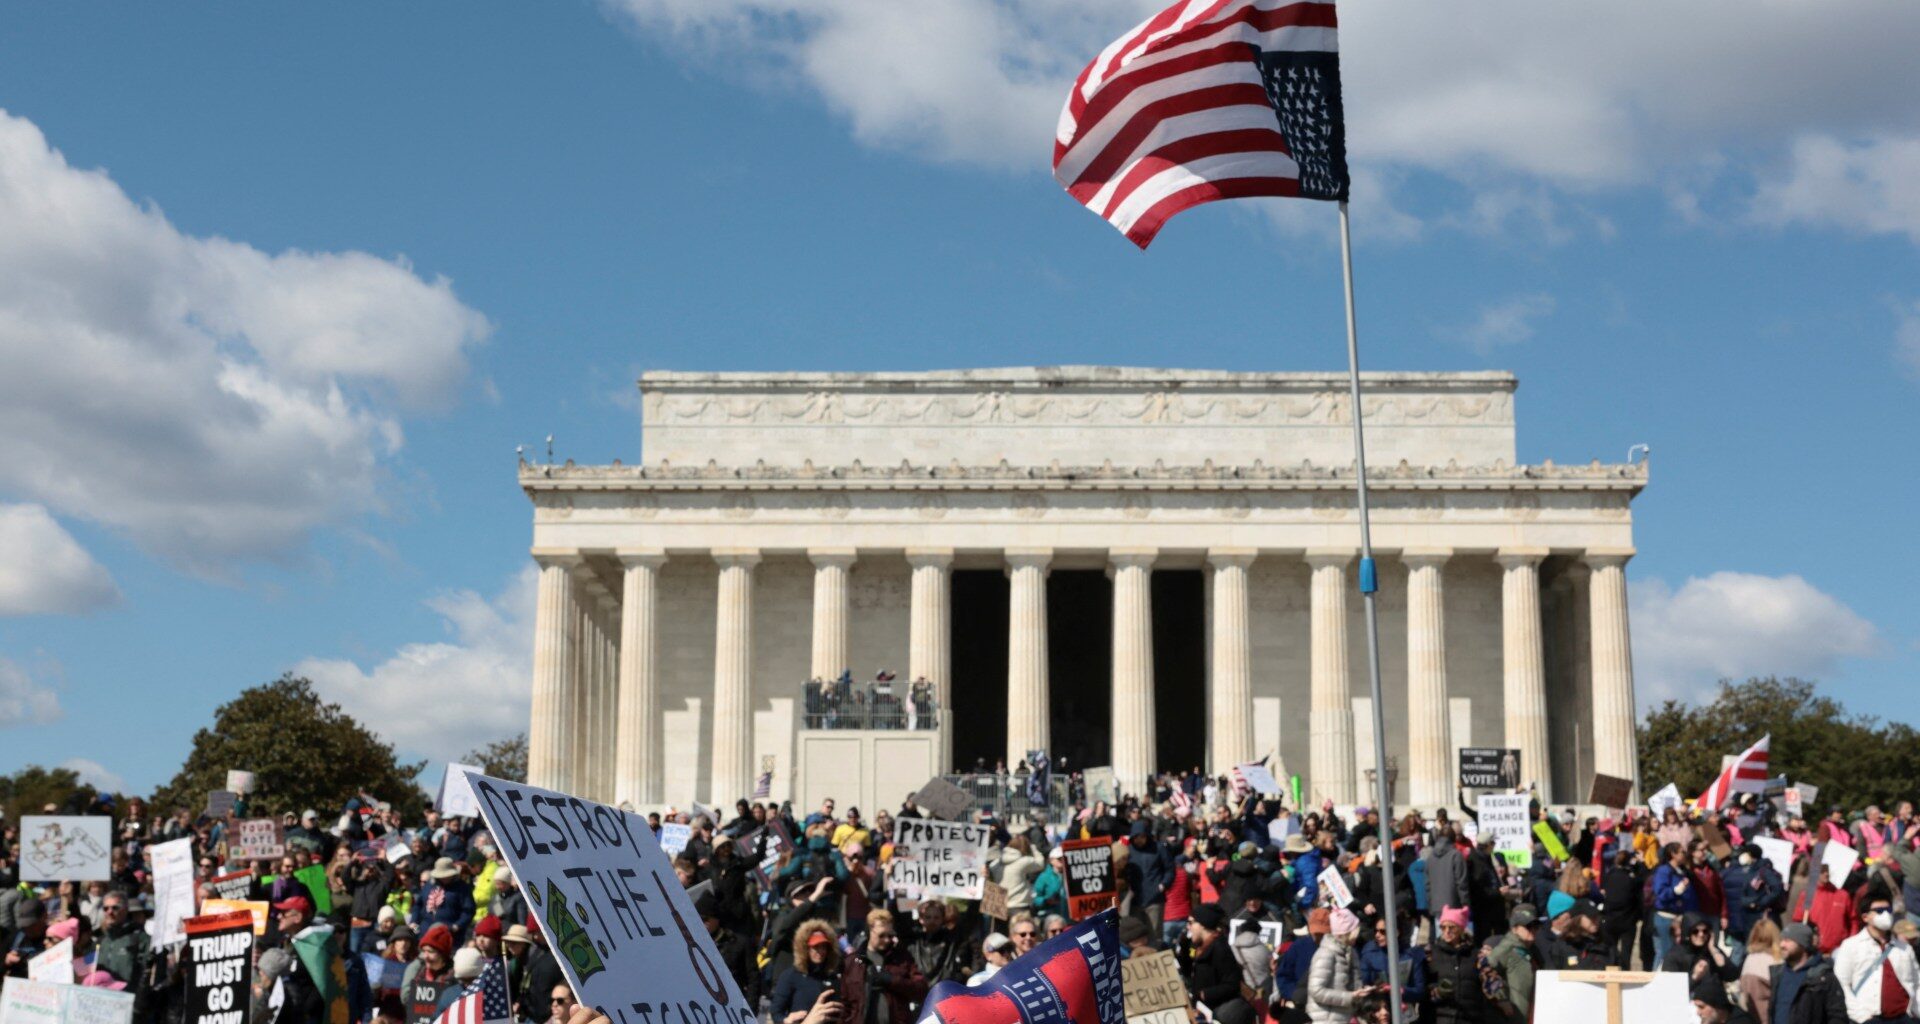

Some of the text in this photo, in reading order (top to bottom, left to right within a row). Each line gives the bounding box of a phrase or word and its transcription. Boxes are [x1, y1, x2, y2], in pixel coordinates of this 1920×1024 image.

[1462, 774, 1498, 785] VOTE!
[1485, 799, 1522, 807] REGIME
[478, 780, 641, 860] DESTROY
[1482, 813, 1524, 821] CHANGE
[242, 824, 271, 833] YOUR
[898, 820, 987, 847] PROTECT
[243, 835, 272, 845] VOTE
[1501, 841, 1511, 849] AT
[921, 847, 952, 861] THE
[1064, 846, 1111, 865] TRUMP
[893, 860, 978, 887] Children
[1071, 861, 1109, 880] MUST
[214, 875, 252, 893] TRUMP
[1082, 878, 1103, 894] GO
[562, 867, 665, 952] THE
[190, 931, 252, 962] TRUMP
[196, 958, 245, 987] MUST
[1121, 953, 1175, 984] DUMP
[207, 985, 234, 1012] GO
[416, 986, 436, 1001] NO
[1123, 979, 1180, 1008] TRUMP
